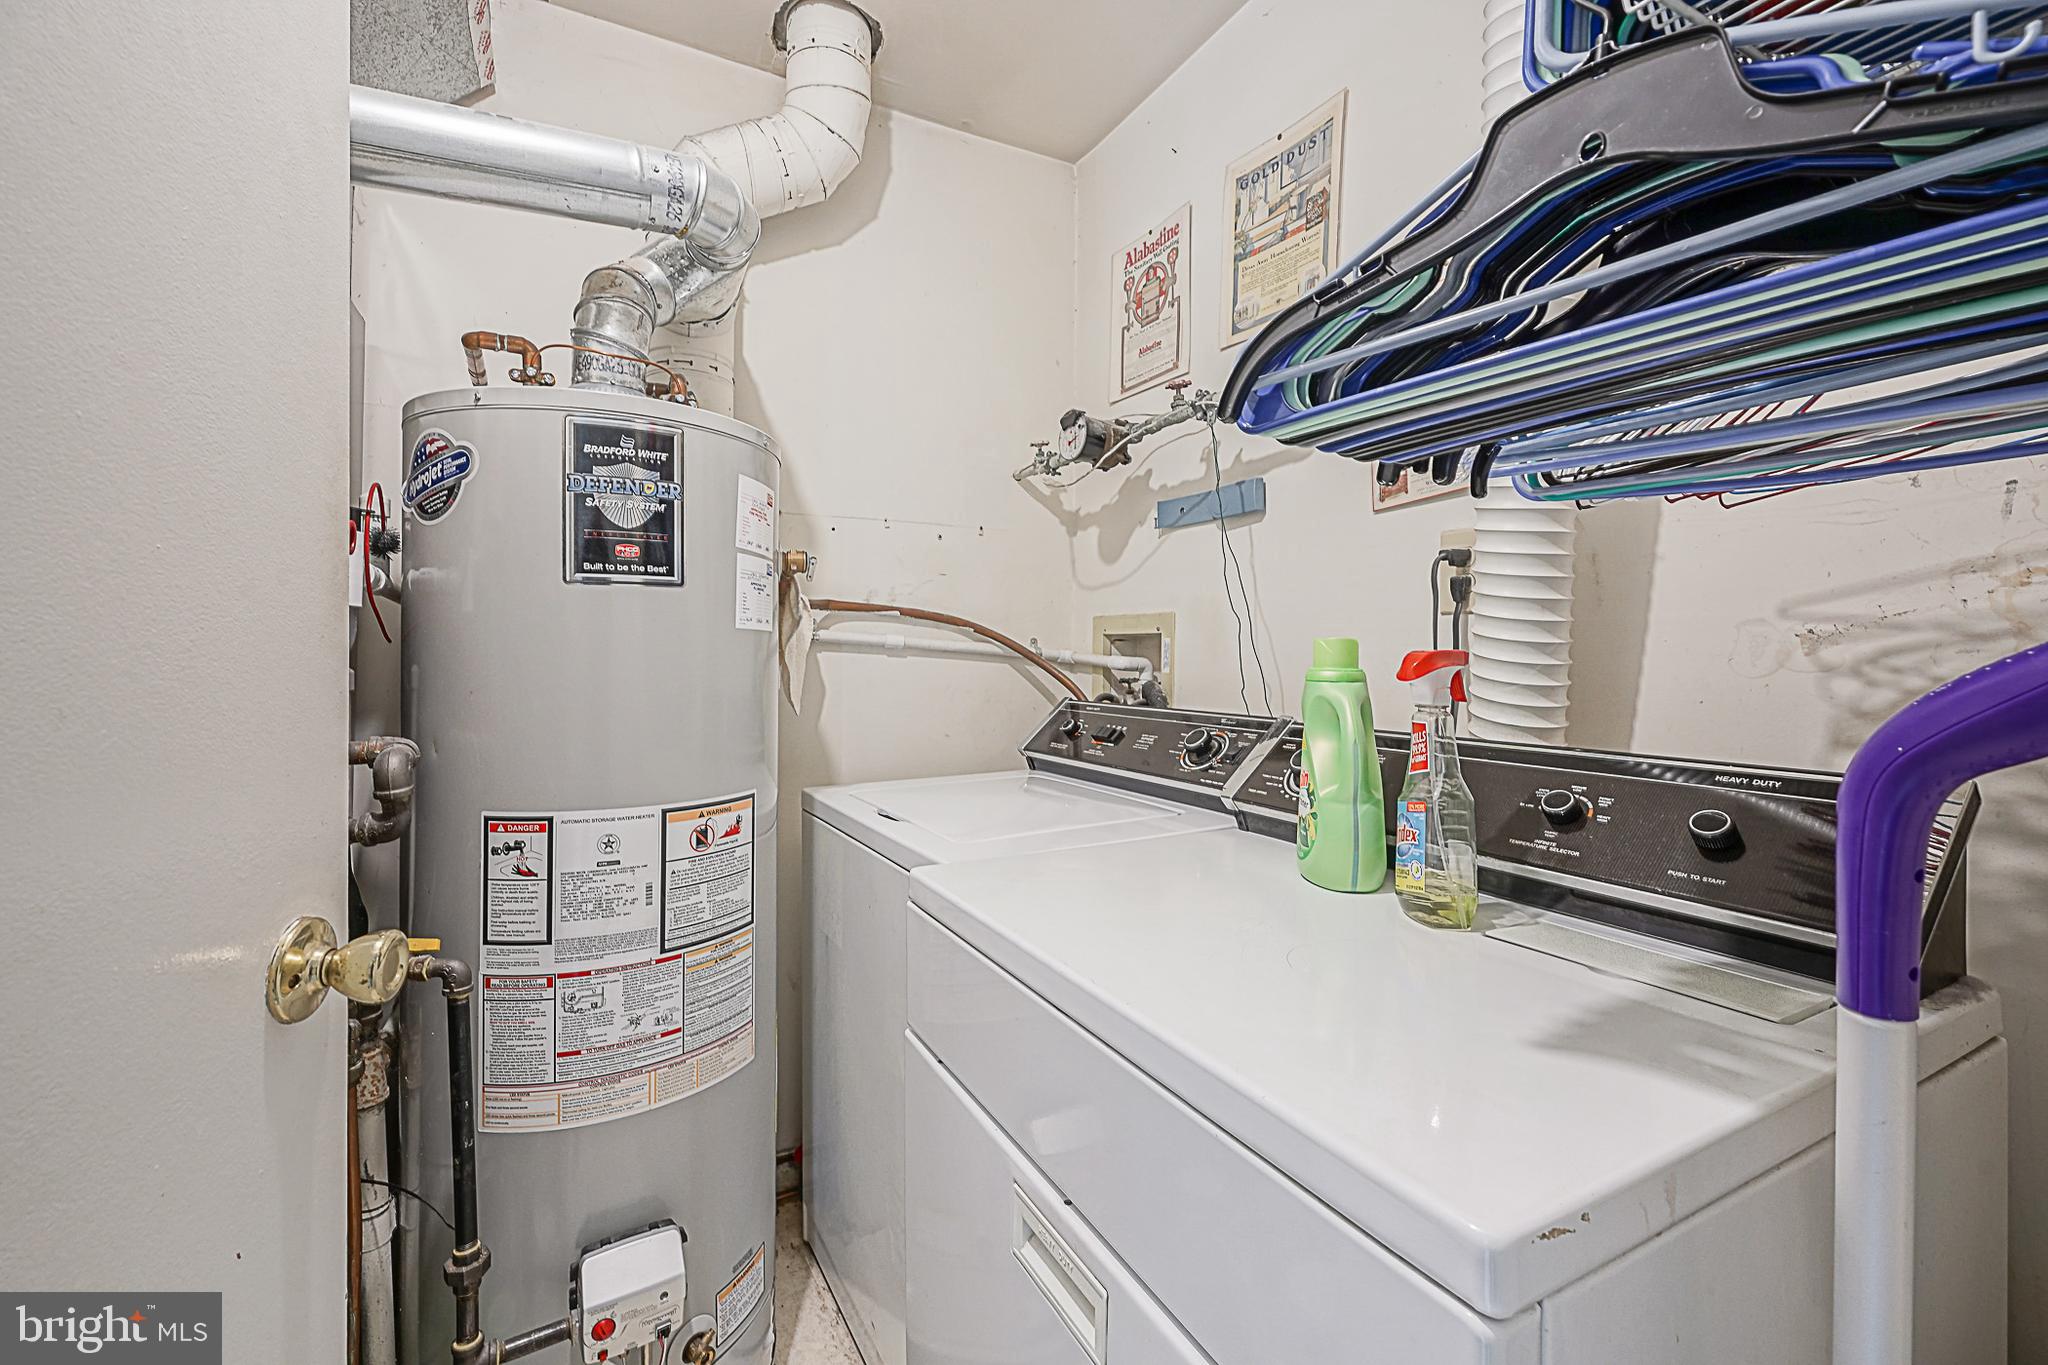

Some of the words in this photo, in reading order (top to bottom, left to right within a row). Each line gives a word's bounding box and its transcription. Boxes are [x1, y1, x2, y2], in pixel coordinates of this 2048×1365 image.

[1240, 161, 1279, 190] GOLD
[1286, 127, 1329, 164] DUST
[1124, 223, 1180, 270] Alabastine
[1124, 268, 1133, 277] The
[1134, 257, 1153, 272] Sanitary
[583, 444, 636, 457] BRADFORD
[638, 449, 668, 461] WHITE
[567, 474, 683, 500] DEFENDER
[585, 497, 623, 508] SAFETY
[626, 500, 666, 512] SYSTEM
[583, 562, 603, 570] Built
[605, 563, 615, 571] to
[617, 563, 629, 571] be
[631, 564, 646, 572] the
[647, 565, 667, 574] Best
[1412, 731, 1426, 743] KILLS
[1715, 774, 1749, 785] HEAVY
[1752, 778, 1782, 788] DUTY
[706, 806, 732, 817] WARNING
[507, 824, 540, 832] DANGER
[1509, 838, 1548, 851] TEMPERATURE
[1548, 845, 1580, 857] SELECTOR
[1534, 839, 1557, 847] INFINITE
[1667, 869, 1688, 879] PUSH
[1690, 873, 1700, 881] TO
[1702, 876, 1727, 886] START
